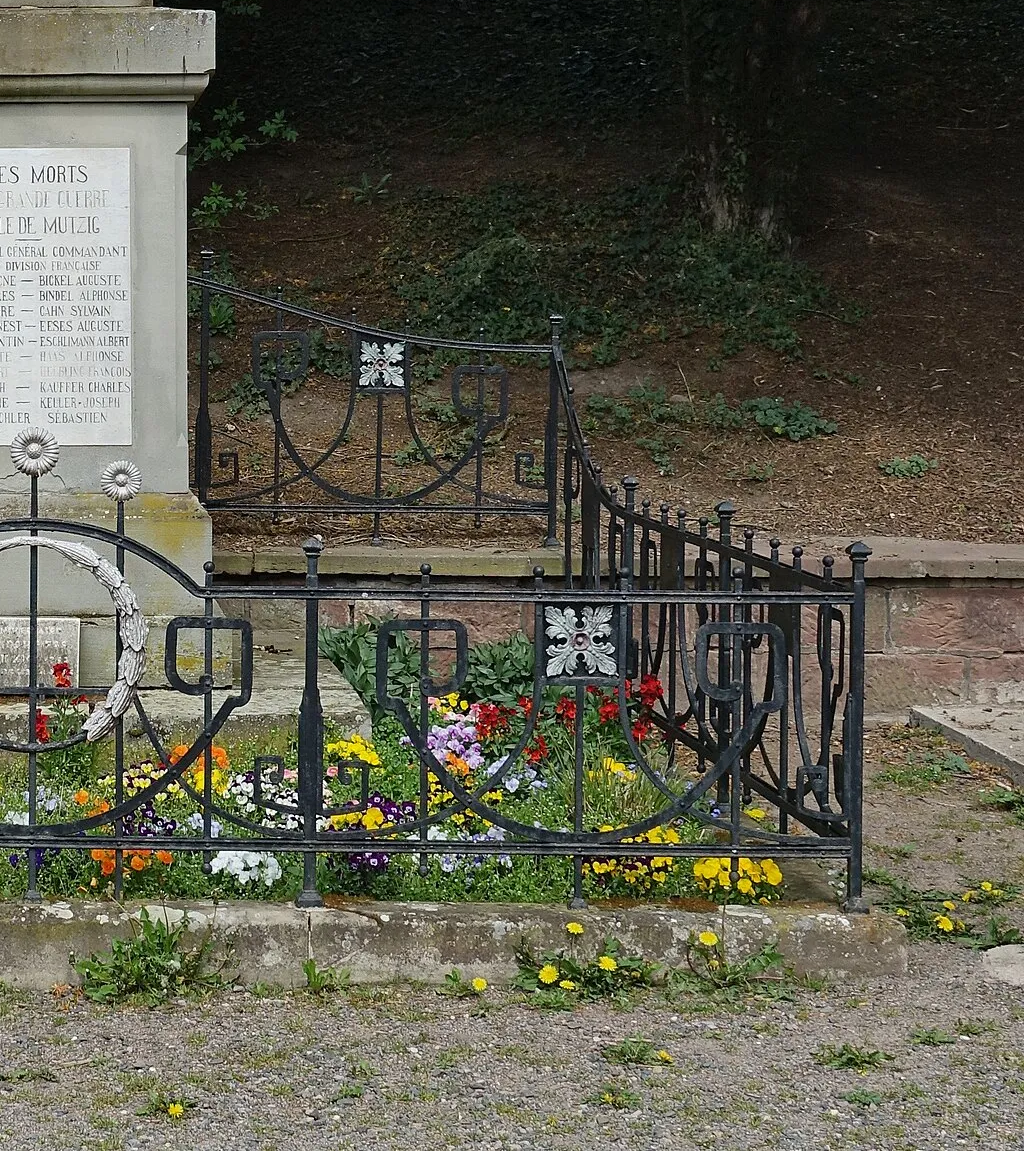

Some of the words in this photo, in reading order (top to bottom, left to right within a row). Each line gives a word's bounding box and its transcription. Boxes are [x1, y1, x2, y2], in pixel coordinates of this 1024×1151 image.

[31, 165, 89, 184] MORTS
[57, 190, 111, 208] GUERRE
[18, 216, 37, 234] DE
[43, 215, 101, 234] MUTZIG
[6, 243, 48, 258] GÉNÉRAL
[52, 246, 129, 257] COMMANDANT
[5, 261, 47, 271] DIVISION
[39, 275, 74, 286] BICKEL
[76, 275, 121, 286] AUGUSTE
[39, 290, 74, 301] BINDEL
[80, 290, 128, 301] ALPHONSE
[39, 305, 64, 316] CAHN
[70, 305, 111, 316] SYLVAIN
[77, 320, 124, 332] AUGUSTE
[40, 336, 95, 347] ESCHLIMANN
[96, 336, 130, 347] ALBERT
[72, 351, 125, 362] ALPHONSE
[88, 382, 131, 393] CHARLES
[40, 397, 77, 409] KELLER
[83, 397, 120, 408] JOSEPH
[47, 409, 108, 424] SÉBASTIEN
